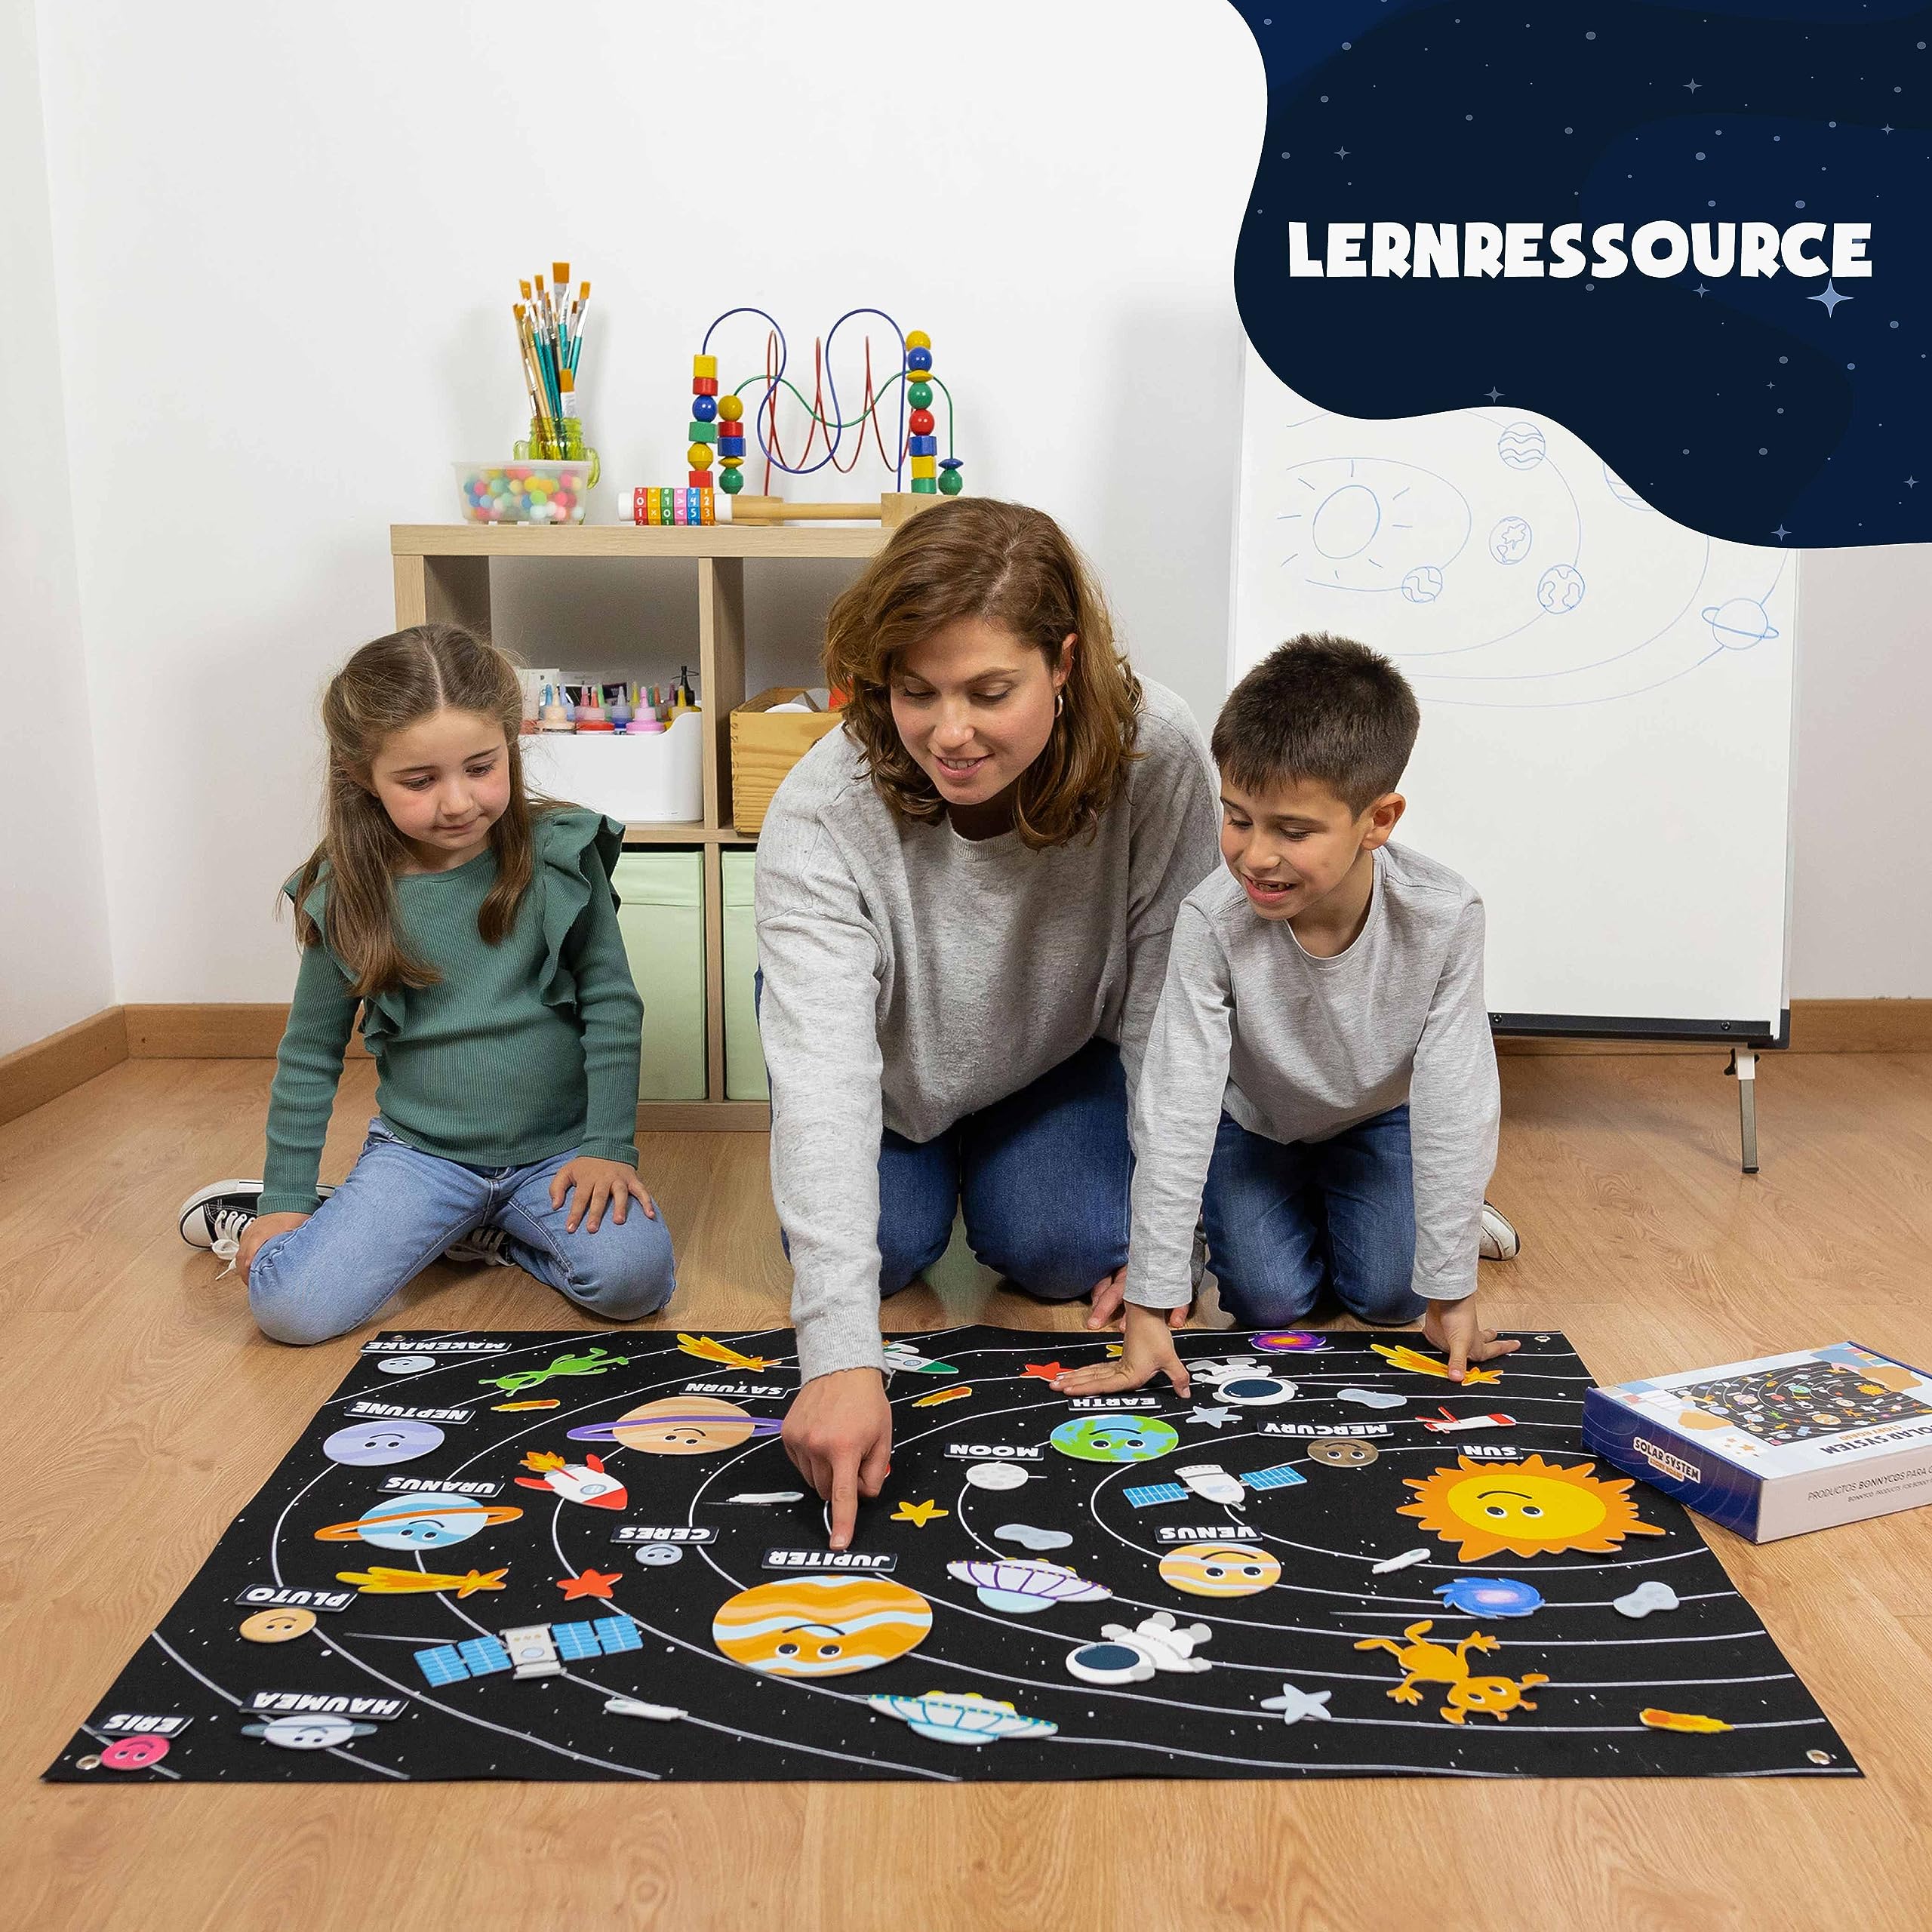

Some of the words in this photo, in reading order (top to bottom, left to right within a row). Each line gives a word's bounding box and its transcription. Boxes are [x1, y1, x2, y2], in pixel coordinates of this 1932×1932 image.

[365, 1341, 507, 1350] MAKEMAKE
[685, 1382, 783, 1396] SATURN
[1073, 1396, 1157, 1408] EARTH
[355, 1401, 469, 1420] NEPTUNE
[1264, 1422, 1389, 1435] MERCURY
[1887, 1425, 1932, 1440] OLAR
[949, 1443, 1038, 1457] MOON
[1463, 1444, 1517, 1457] SUN
[1820, 1435, 1889, 1454] SYSTEM
[1635, 1439, 1664, 1461] SOLAR
[1665, 1454, 1700, 1481] SYSTEM
[385, 1476, 498, 1495] URANUS
[618, 1526, 712, 1542] CERES
[1161, 1525, 1258, 1540] VENUS
[768, 1550, 891, 1567] JUPITER
[245, 1586, 349, 1608] PLUTO
[253, 1691, 401, 1715] HAUMEA
[103, 1714, 184, 1734] ERIS
